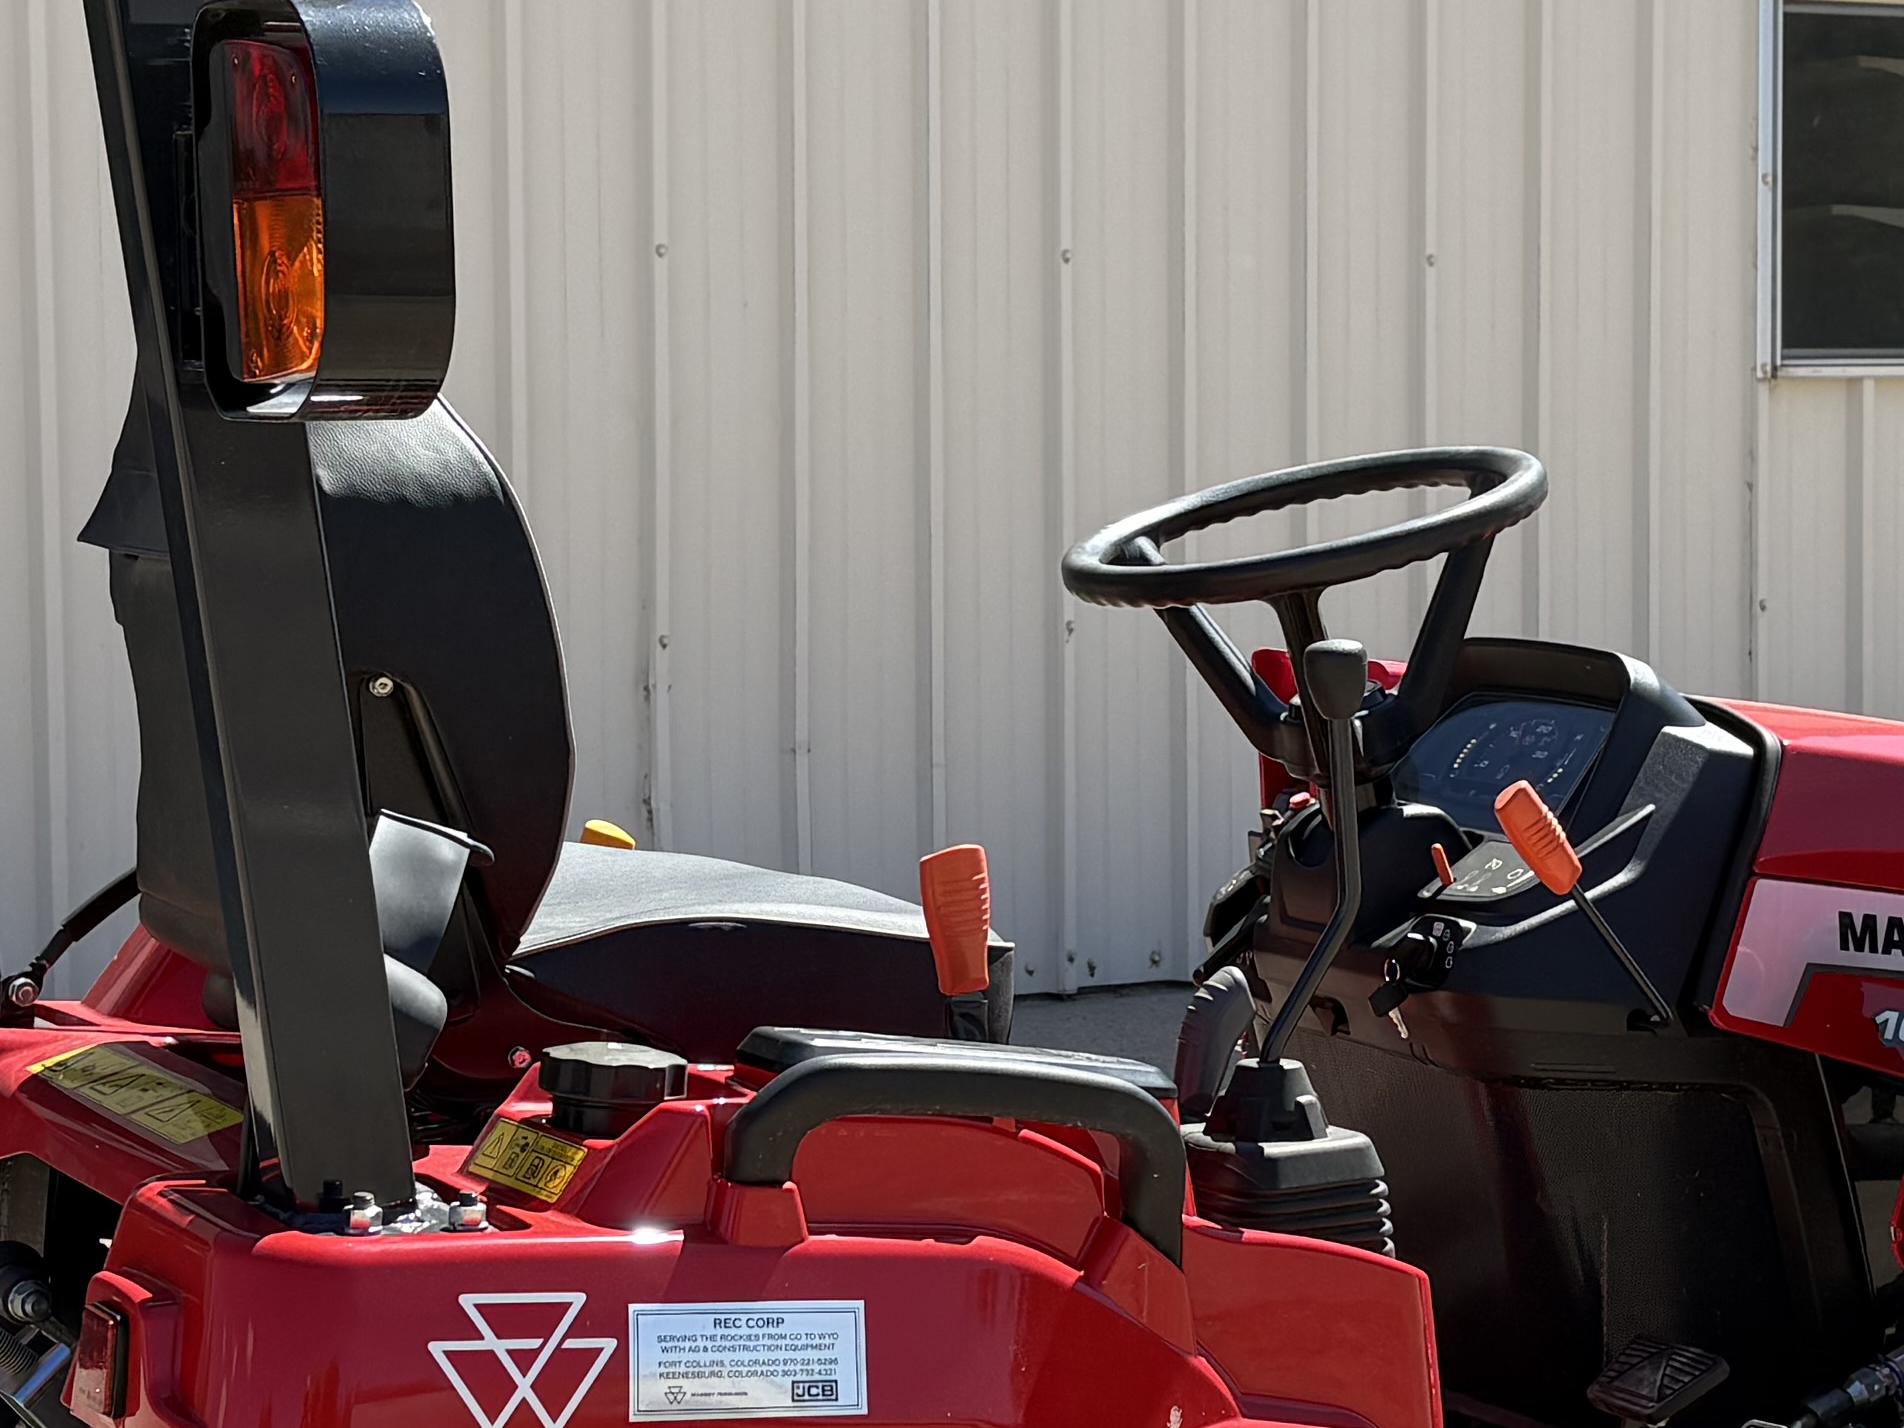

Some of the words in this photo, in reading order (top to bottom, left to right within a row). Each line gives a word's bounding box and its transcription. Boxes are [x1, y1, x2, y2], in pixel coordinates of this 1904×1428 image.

[713, 1317, 744, 1329] REC
[745, 1317, 785, 1329] CORP
[657, 1334, 698, 1343] SERVING
[700, 1333, 717, 1342] THE
[719, 1333, 760, 1342] ROCKIES
[762, 1333, 787, 1341] FROM
[788, 1332, 802, 1341] CO
[804, 1332, 817, 1340] TO
[817, 1332, 839, 1340] WYO
[660, 1345, 686, 1354] WITH
[710, 1343, 783, 1353] CONSTRUCTION
[784, 1343, 836, 1352] EQUIPMENT
[658, 1360, 683, 1369] FORT
[728, 1358, 781, 1367] COLORADO
[727, 1369, 780, 1378] COLORADO
[795, 1384, 835, 1398] JCB
